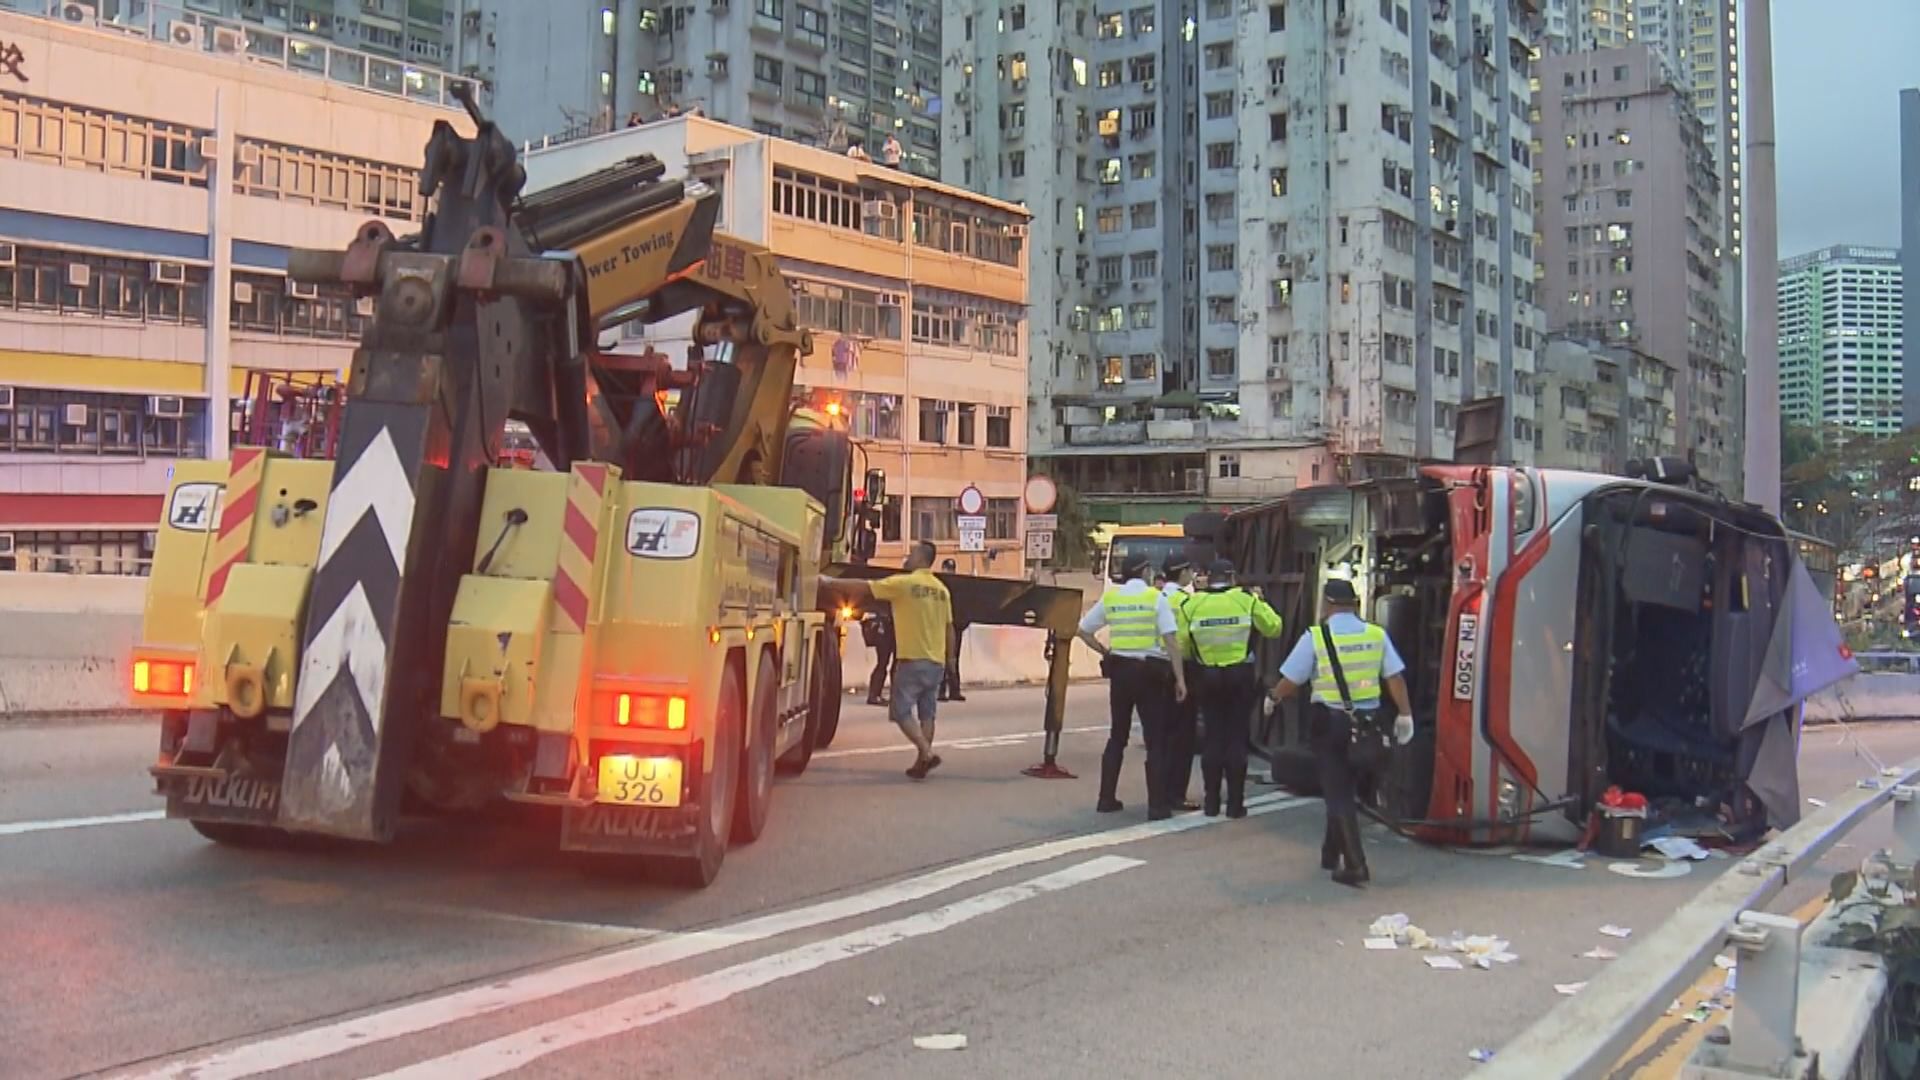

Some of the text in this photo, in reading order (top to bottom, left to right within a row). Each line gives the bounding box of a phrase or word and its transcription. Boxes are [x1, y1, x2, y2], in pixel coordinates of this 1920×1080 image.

[620, 229, 675, 264] Towing
[1456, 617, 1476, 696] PN 3509
[624, 760, 657, 782] UJ
[614, 781, 664, 803] 326
